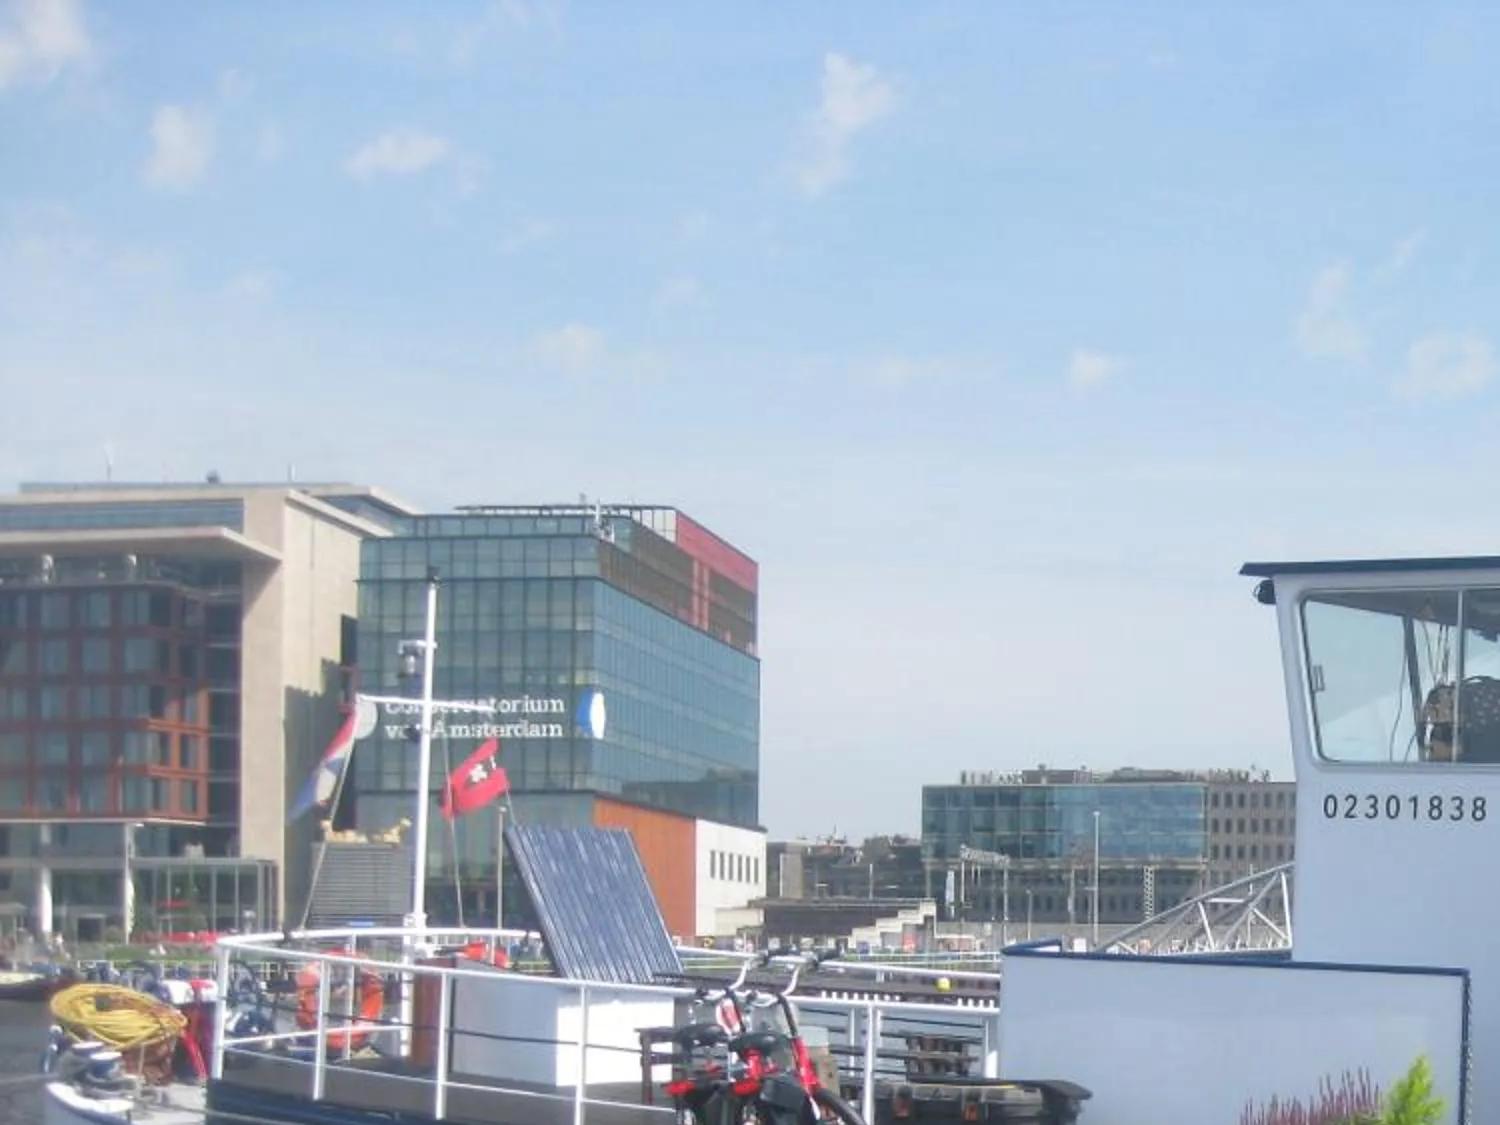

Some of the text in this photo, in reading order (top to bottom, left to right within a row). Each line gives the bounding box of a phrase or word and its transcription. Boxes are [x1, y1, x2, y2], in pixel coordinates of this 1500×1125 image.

[385, 695, 565, 714] Coeatorium
[384, 719, 563, 739] va Amsterdam
[1323, 794, 1487, 822] 02301838
